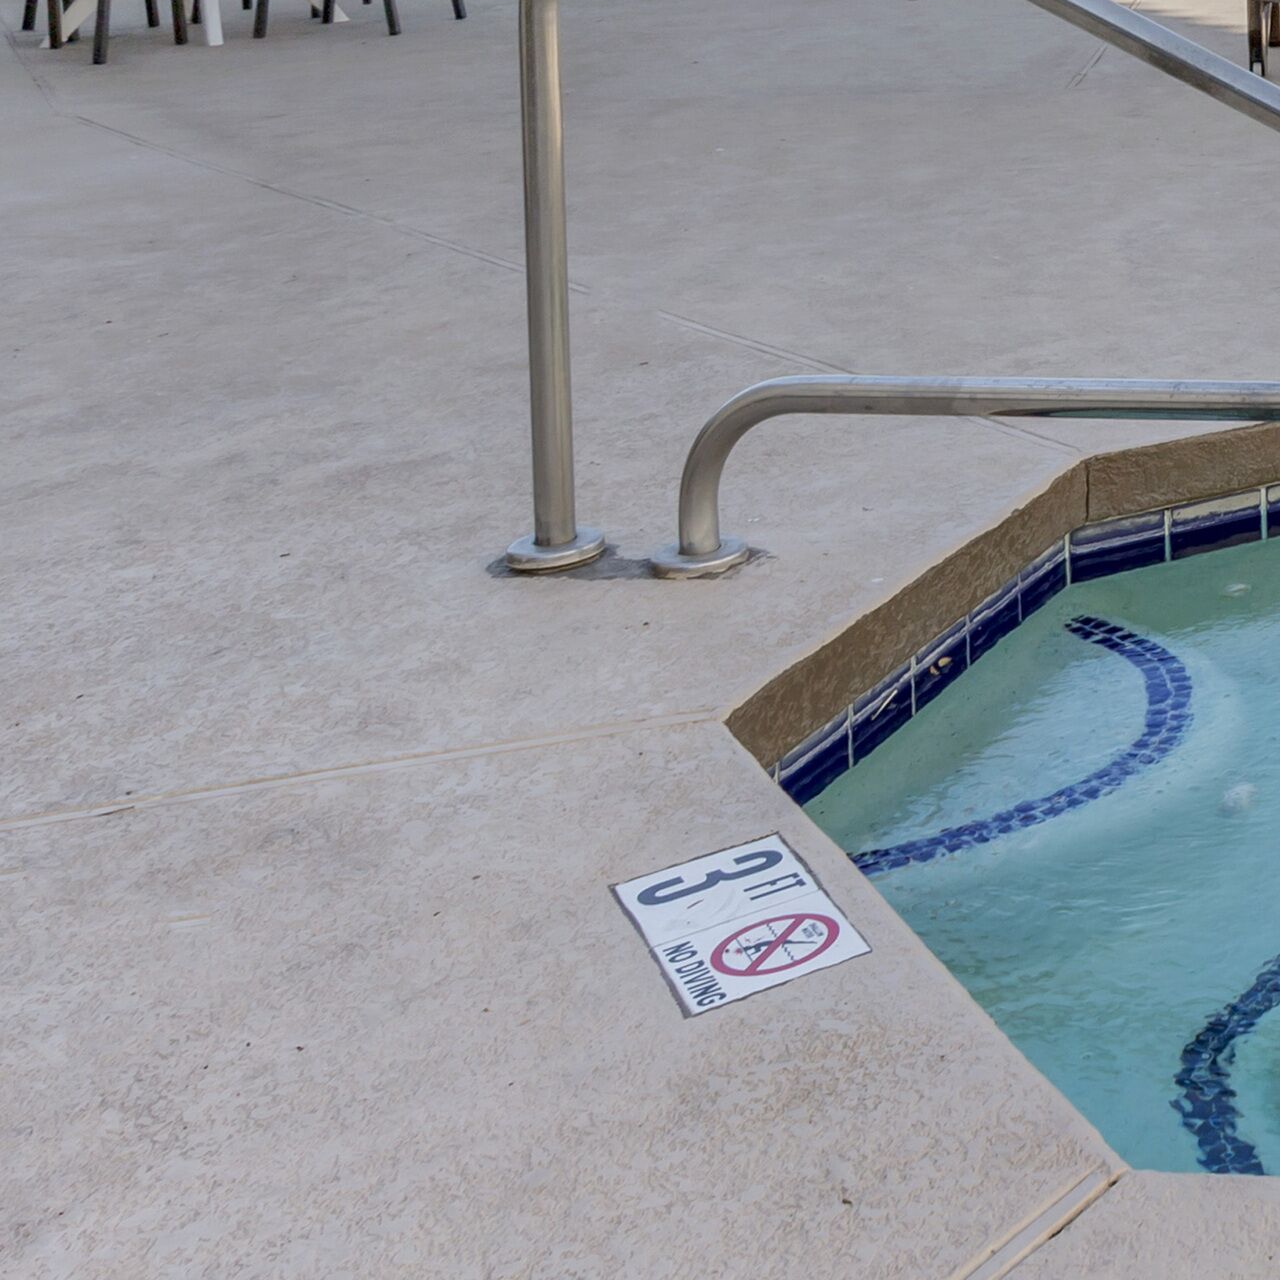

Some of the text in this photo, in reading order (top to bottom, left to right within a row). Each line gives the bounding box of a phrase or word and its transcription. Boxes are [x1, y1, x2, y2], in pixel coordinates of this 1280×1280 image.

[637, 849, 806, 906] 3 FT
[662, 940, 727, 1007] NO DIVING
